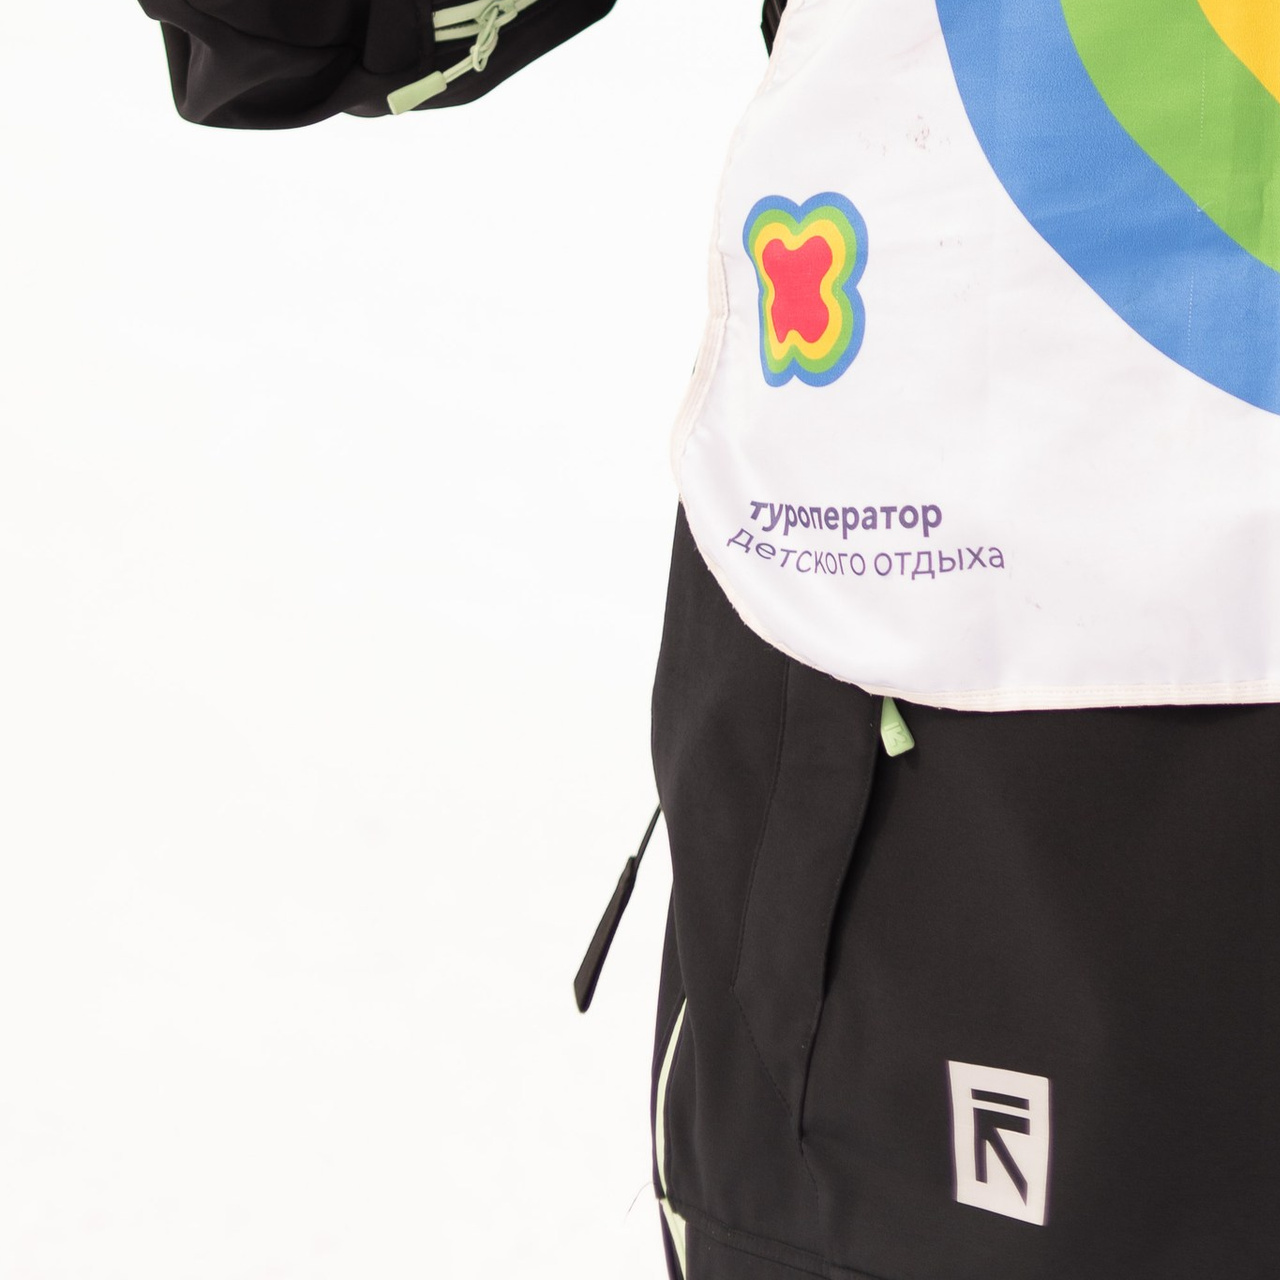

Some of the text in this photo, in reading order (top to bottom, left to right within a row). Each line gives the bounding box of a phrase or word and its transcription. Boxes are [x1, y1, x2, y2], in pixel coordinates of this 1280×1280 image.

[749, 500, 943, 540] туроператор
[726, 528, 1005, 580] детского отдыха
